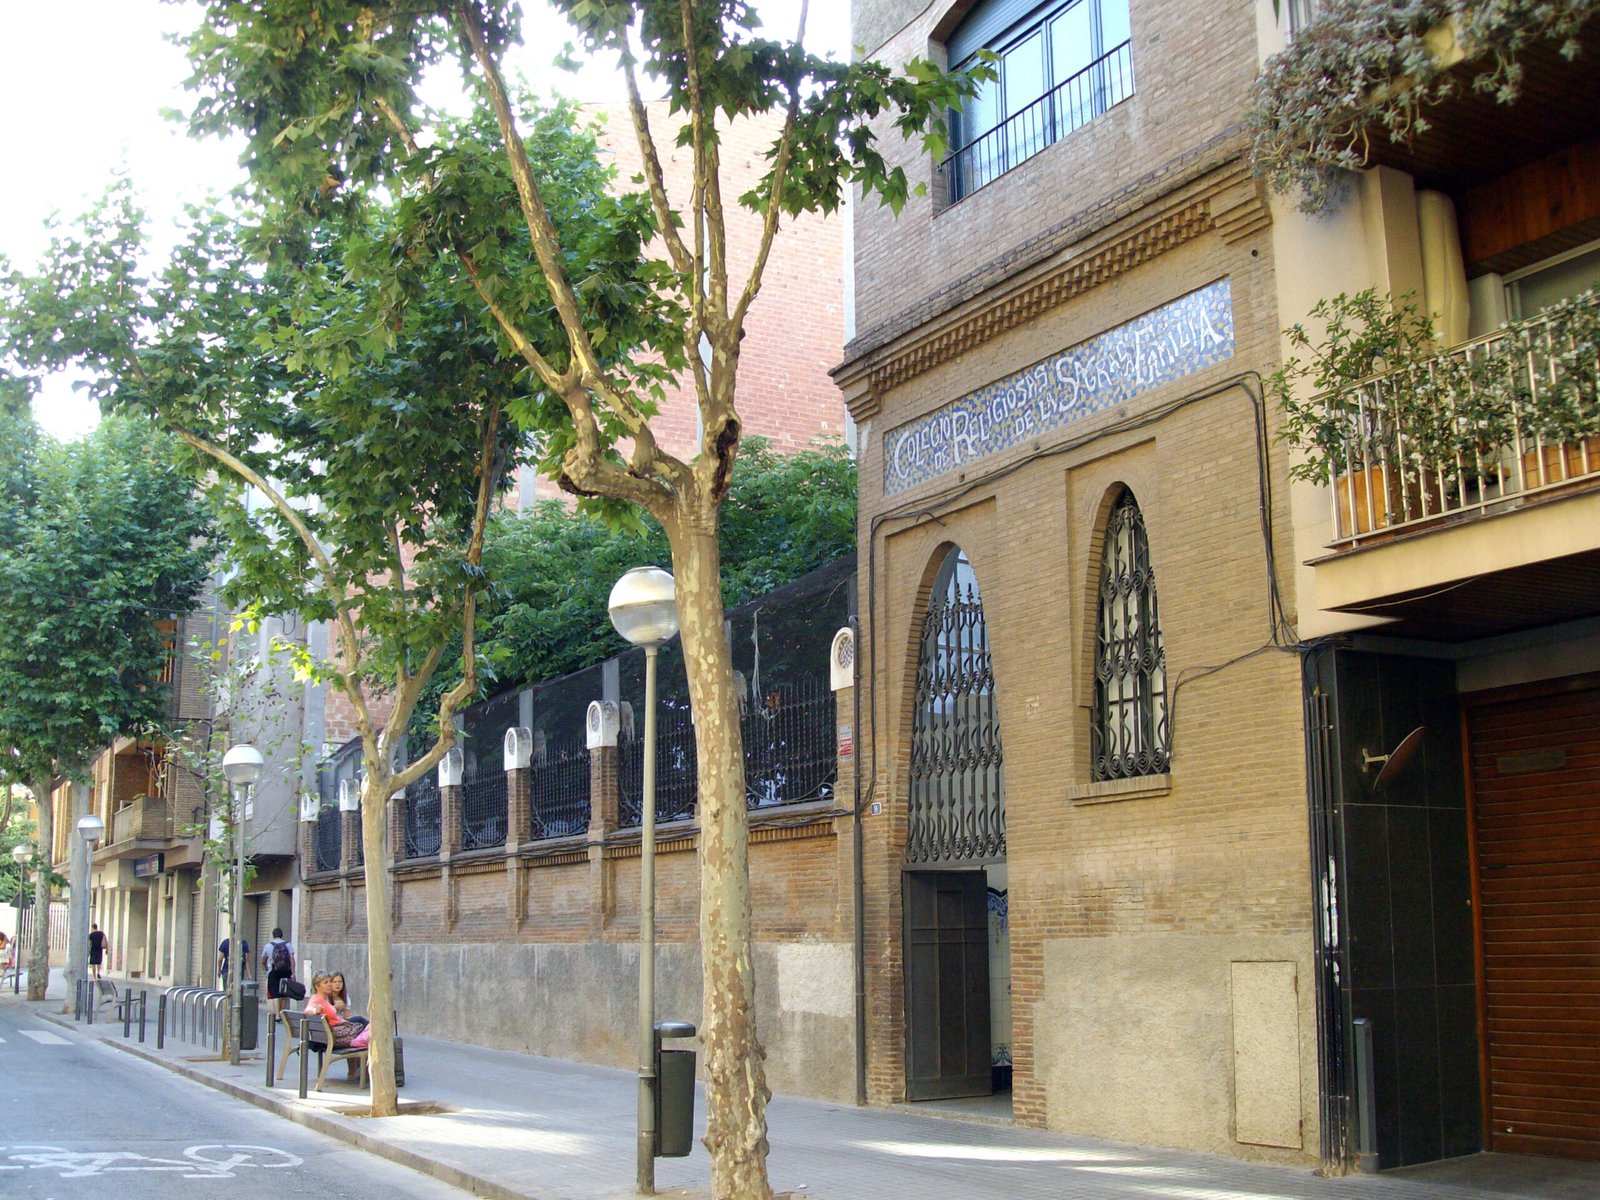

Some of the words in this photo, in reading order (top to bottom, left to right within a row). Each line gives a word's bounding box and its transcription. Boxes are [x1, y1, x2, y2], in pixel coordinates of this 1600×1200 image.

[894, 415, 951, 479] COLEGIO
[934, 446, 950, 470] DE
[1015, 410, 1034, 436] DE
[1038, 392, 1058, 421] LA
[1135, 305, 1225, 385] FAMILIA
